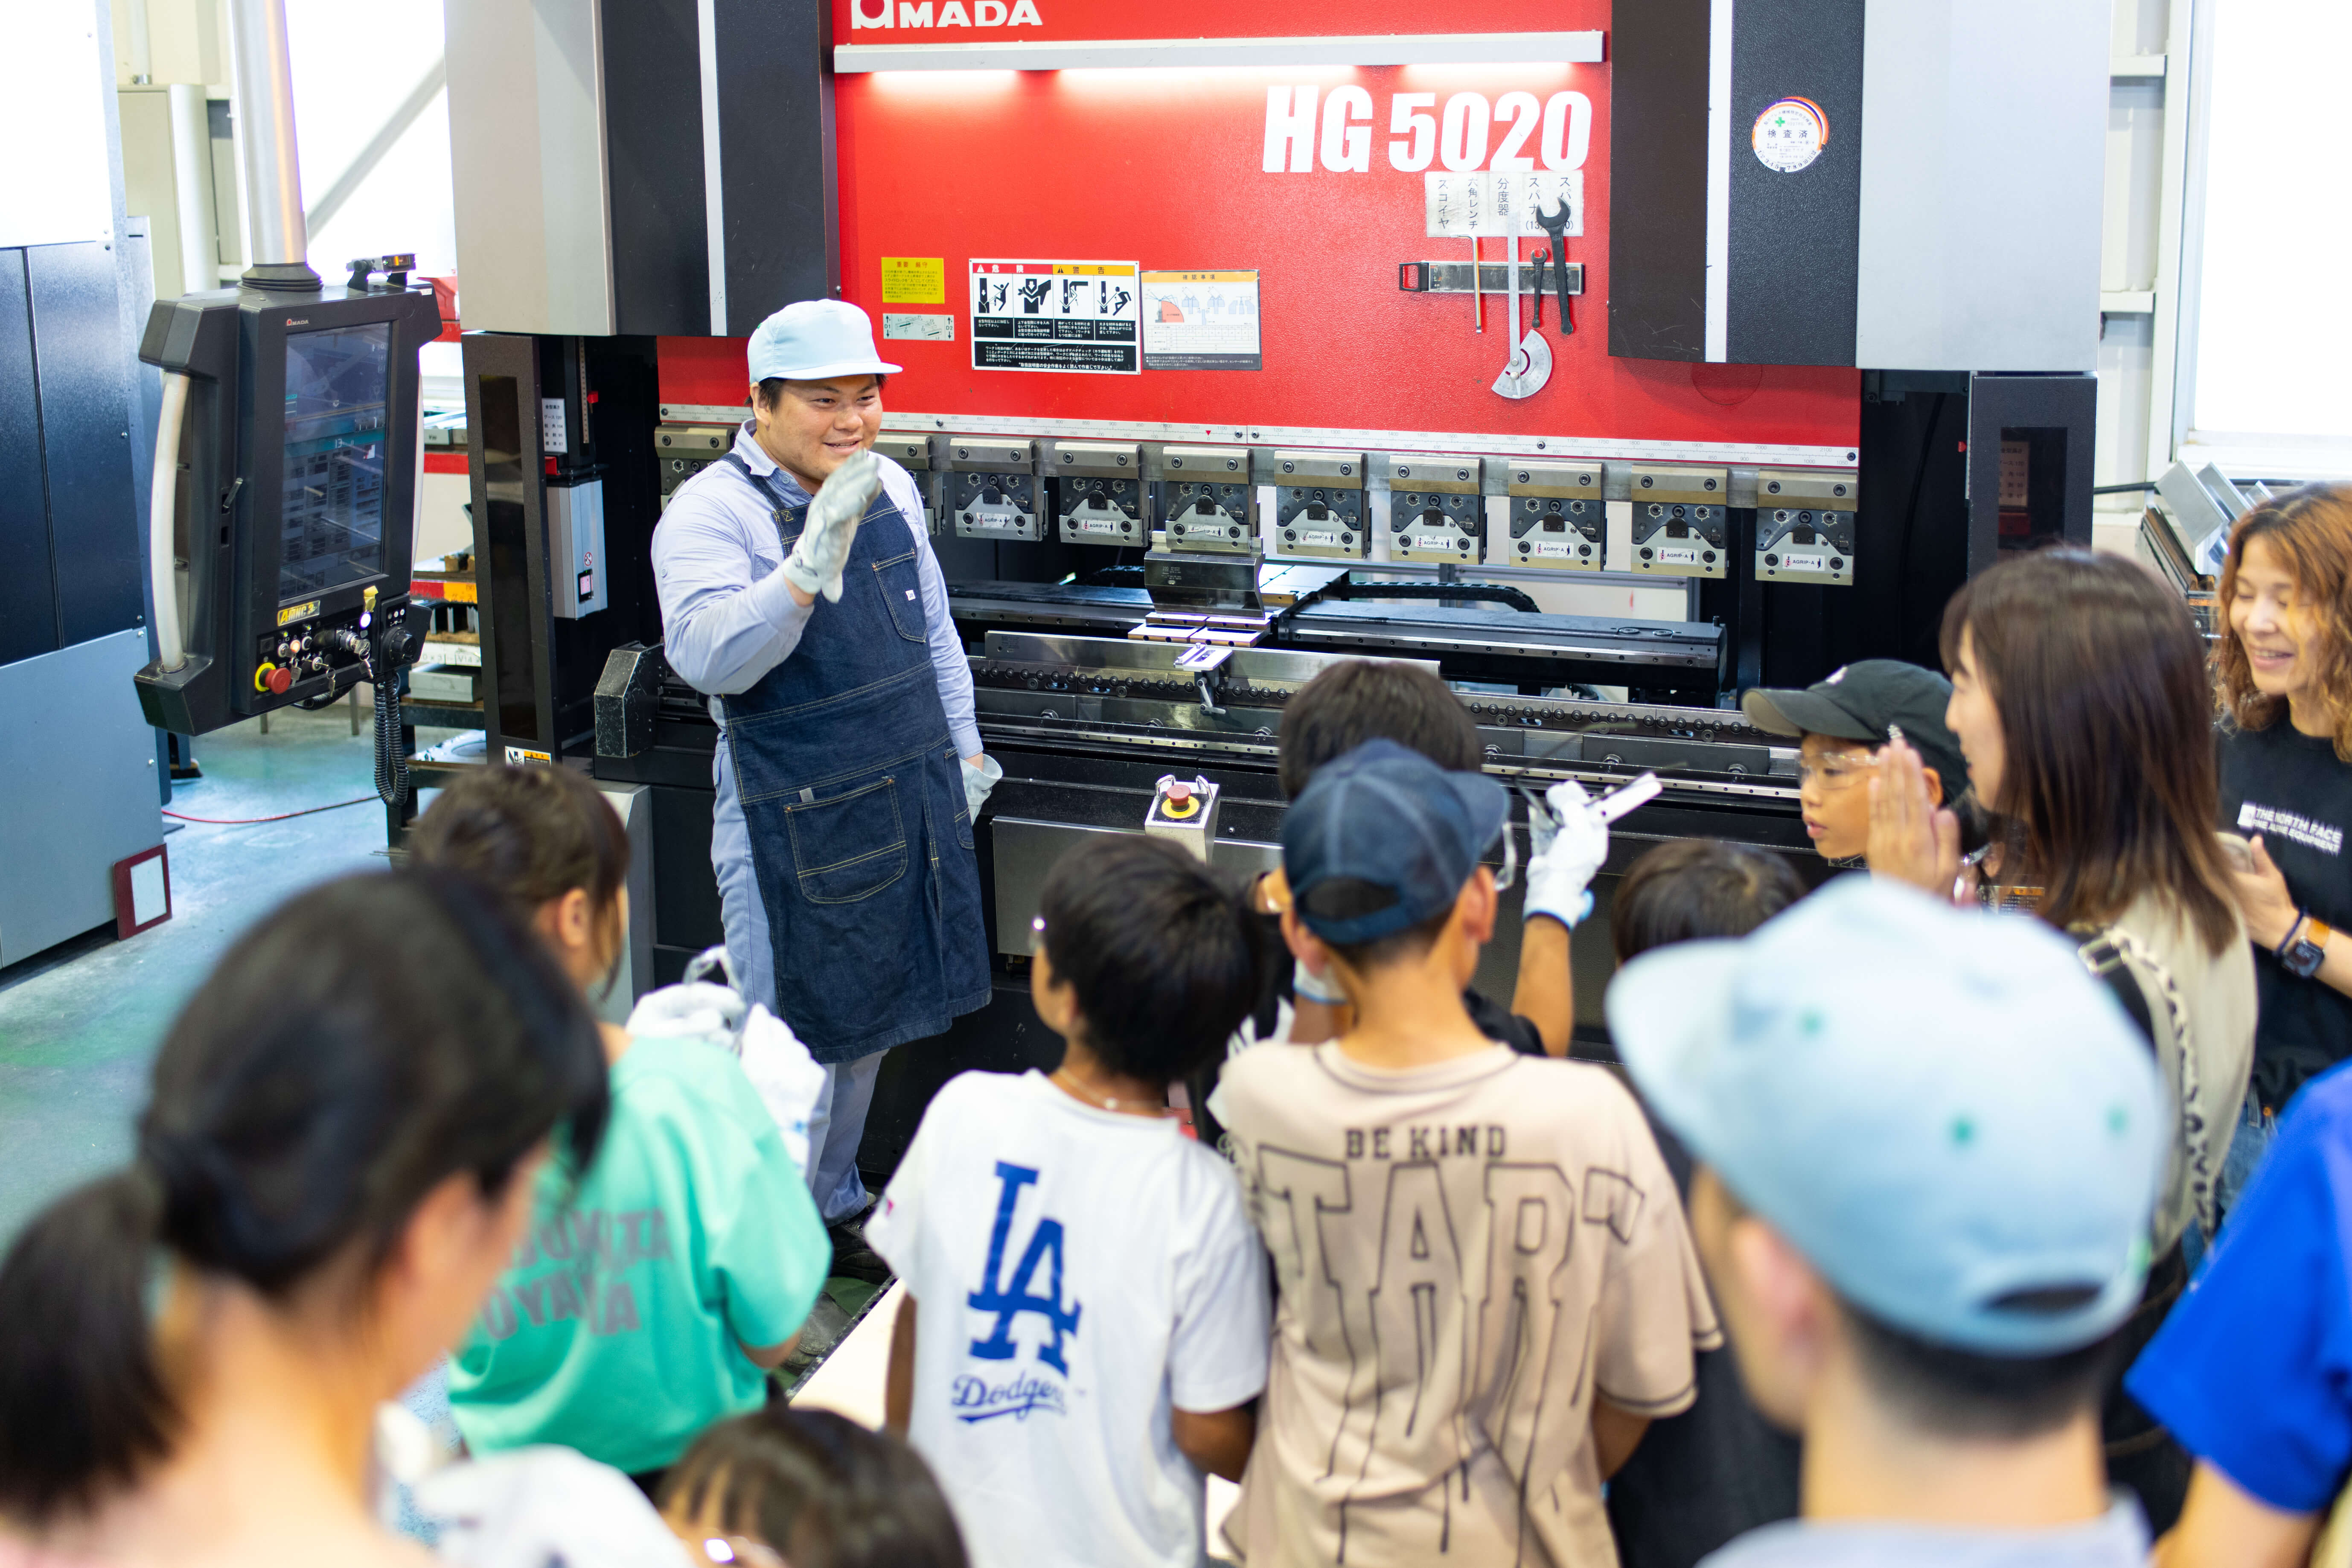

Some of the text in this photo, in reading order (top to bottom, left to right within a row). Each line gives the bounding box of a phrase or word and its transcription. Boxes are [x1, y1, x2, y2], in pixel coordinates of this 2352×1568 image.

[1262, 84, 1592, 173] HG 5020
[1767, 129, 1808, 138] 検査済
[1438, 180, 1449, 229] スコイヤ
[1468, 177, 1478, 230] 六角レンチ
[1497, 177, 1509, 216] 分度器
[1529, 177, 1540, 215] スパナ
[992, 265, 1024, 273] 危険
[2256, 808, 2342, 844] THE NORTH FACE
[1345, 1125, 1505, 1159] BE KIND
[967, 1160, 1083, 1379] LA
